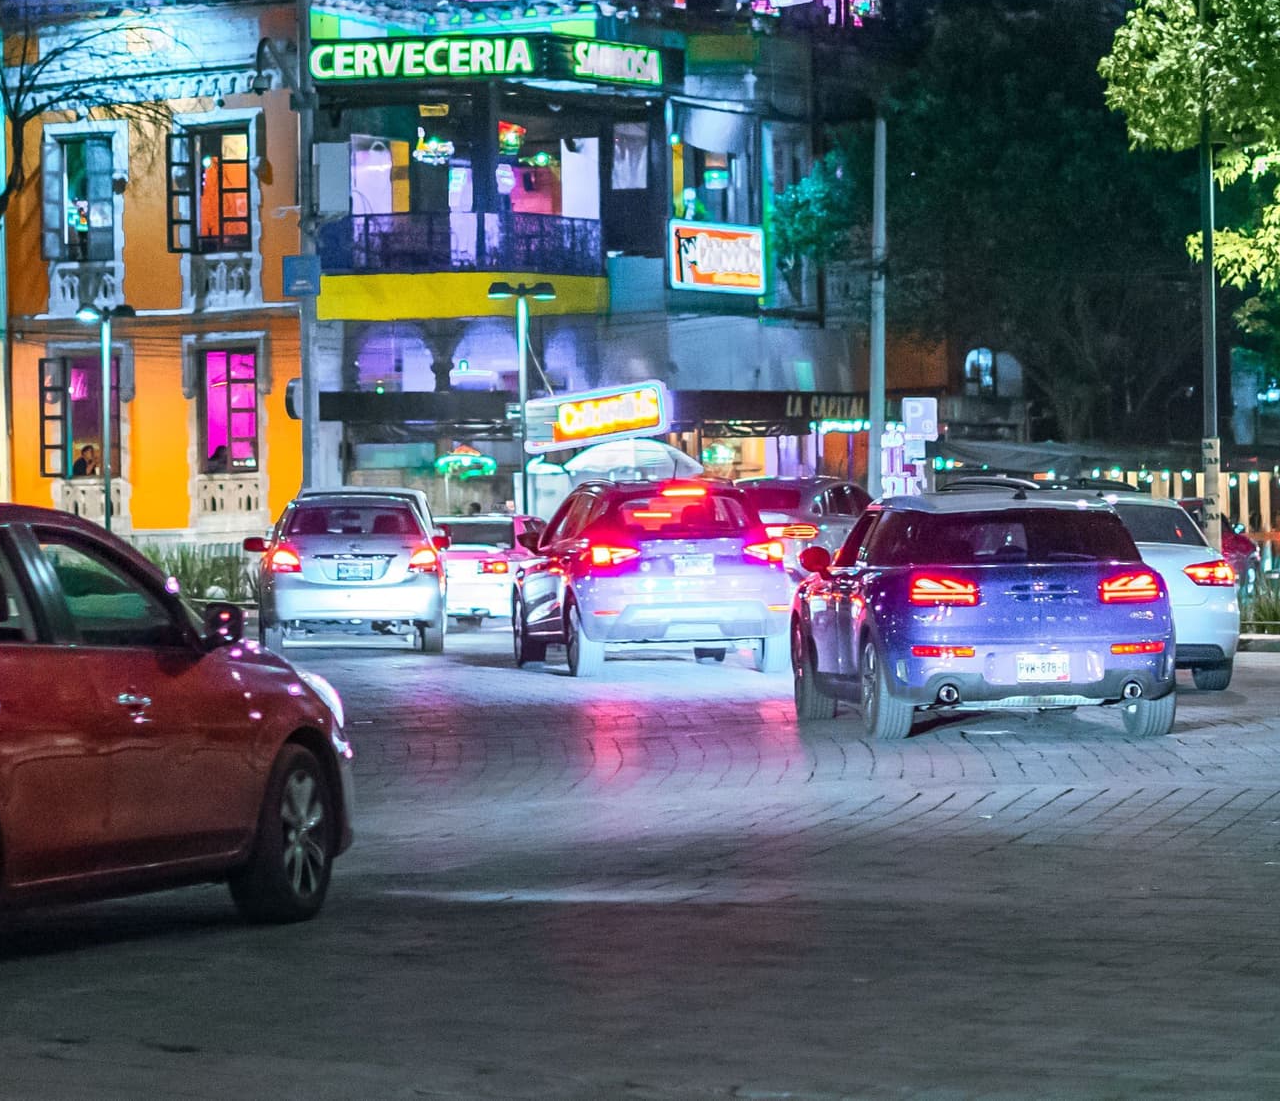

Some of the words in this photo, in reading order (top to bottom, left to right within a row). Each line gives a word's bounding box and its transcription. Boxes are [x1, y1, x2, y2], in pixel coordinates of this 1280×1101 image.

[311, 38, 532, 77] CERVECERIA
[785, 394, 803, 417] LA
[810, 395, 865, 419] CAPITAL
